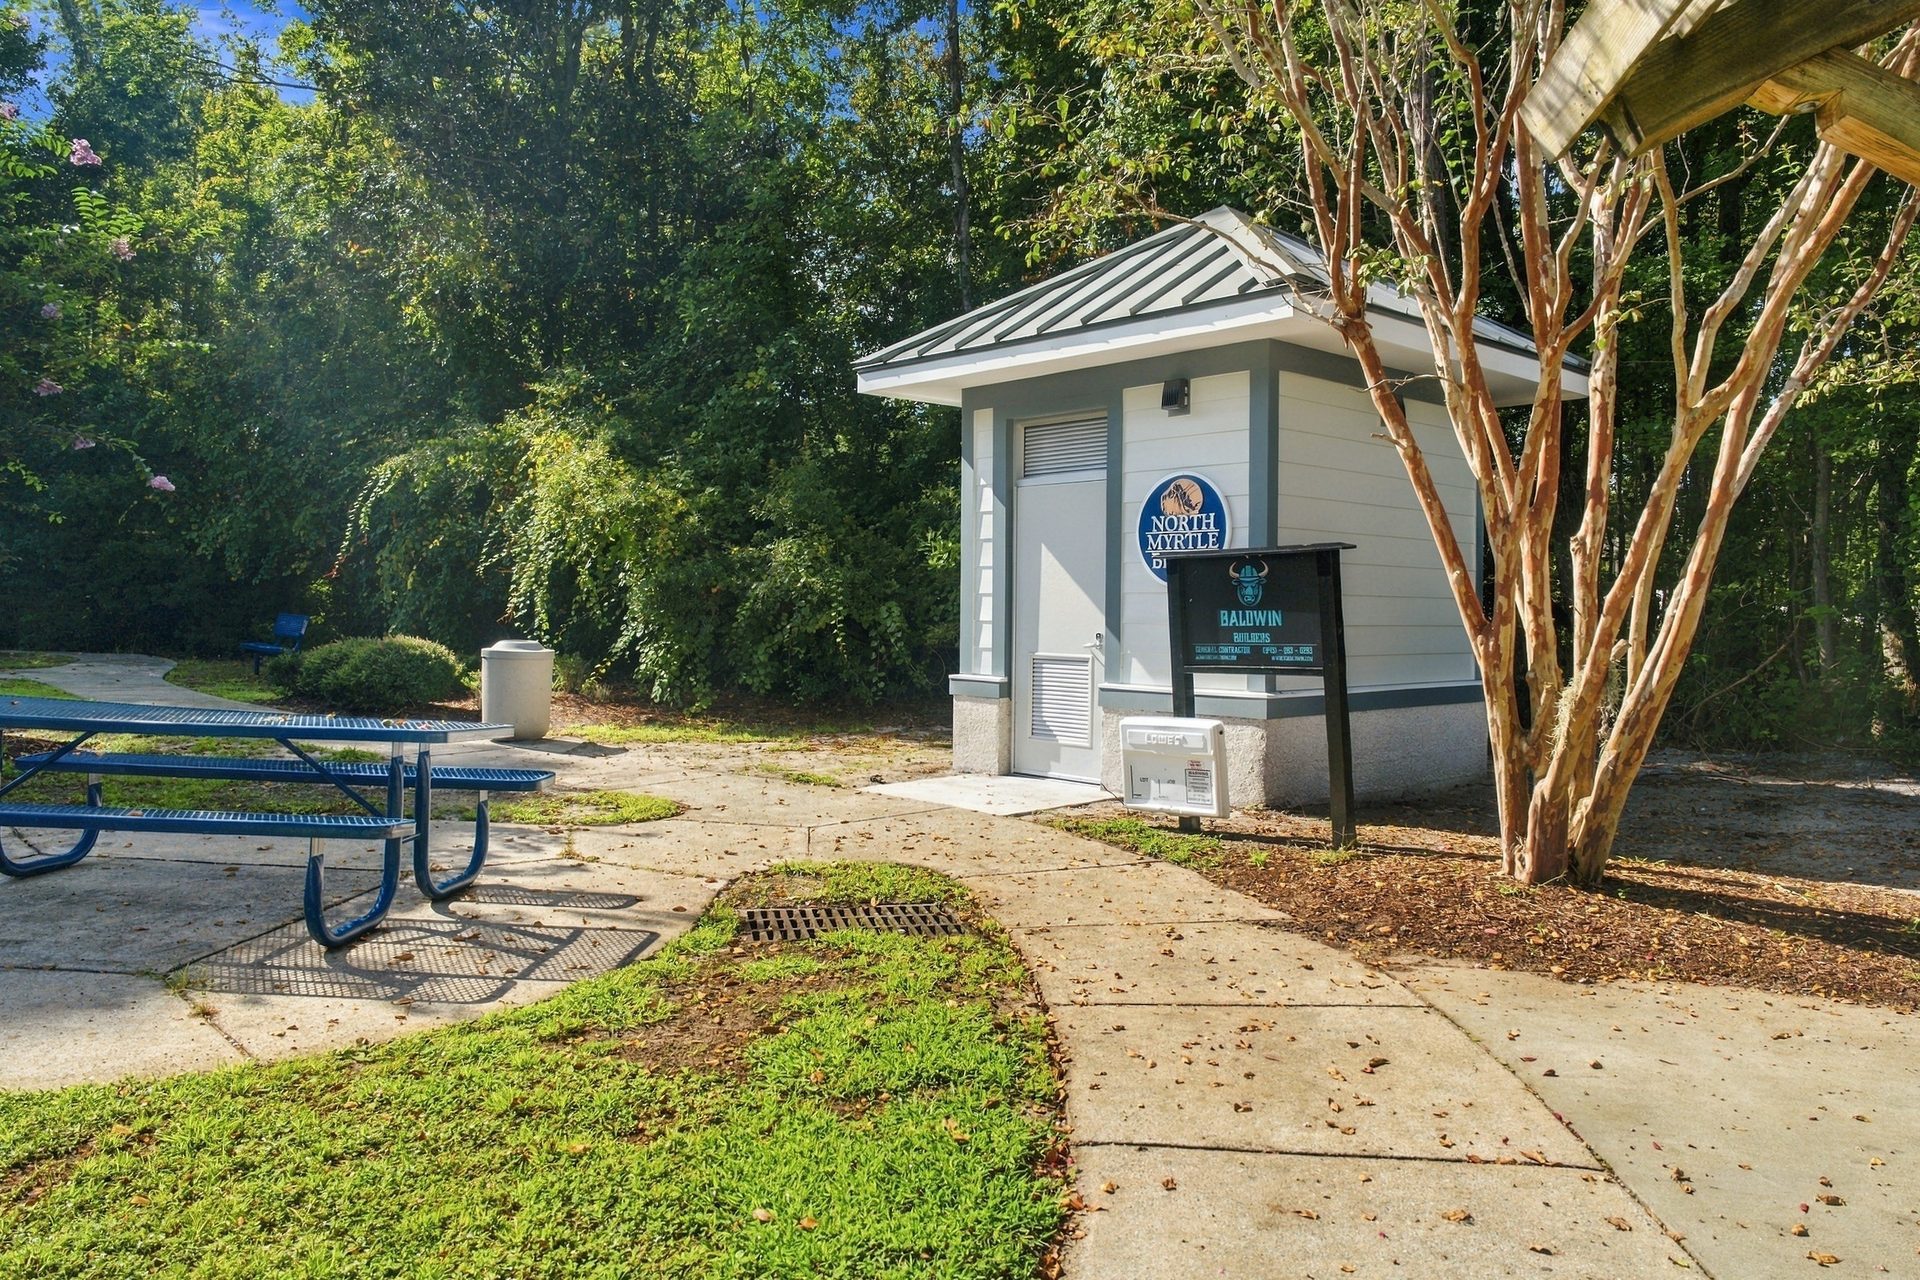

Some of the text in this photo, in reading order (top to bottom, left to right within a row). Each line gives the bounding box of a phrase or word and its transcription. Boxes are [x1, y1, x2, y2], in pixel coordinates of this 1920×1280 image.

[1151, 513, 1216, 532] NORTH
[1146, 532, 1220, 551] MYRTLE
[1219, 610, 1282, 627] BALDWIN
[1233, 632, 1271, 643] BUILDERS
